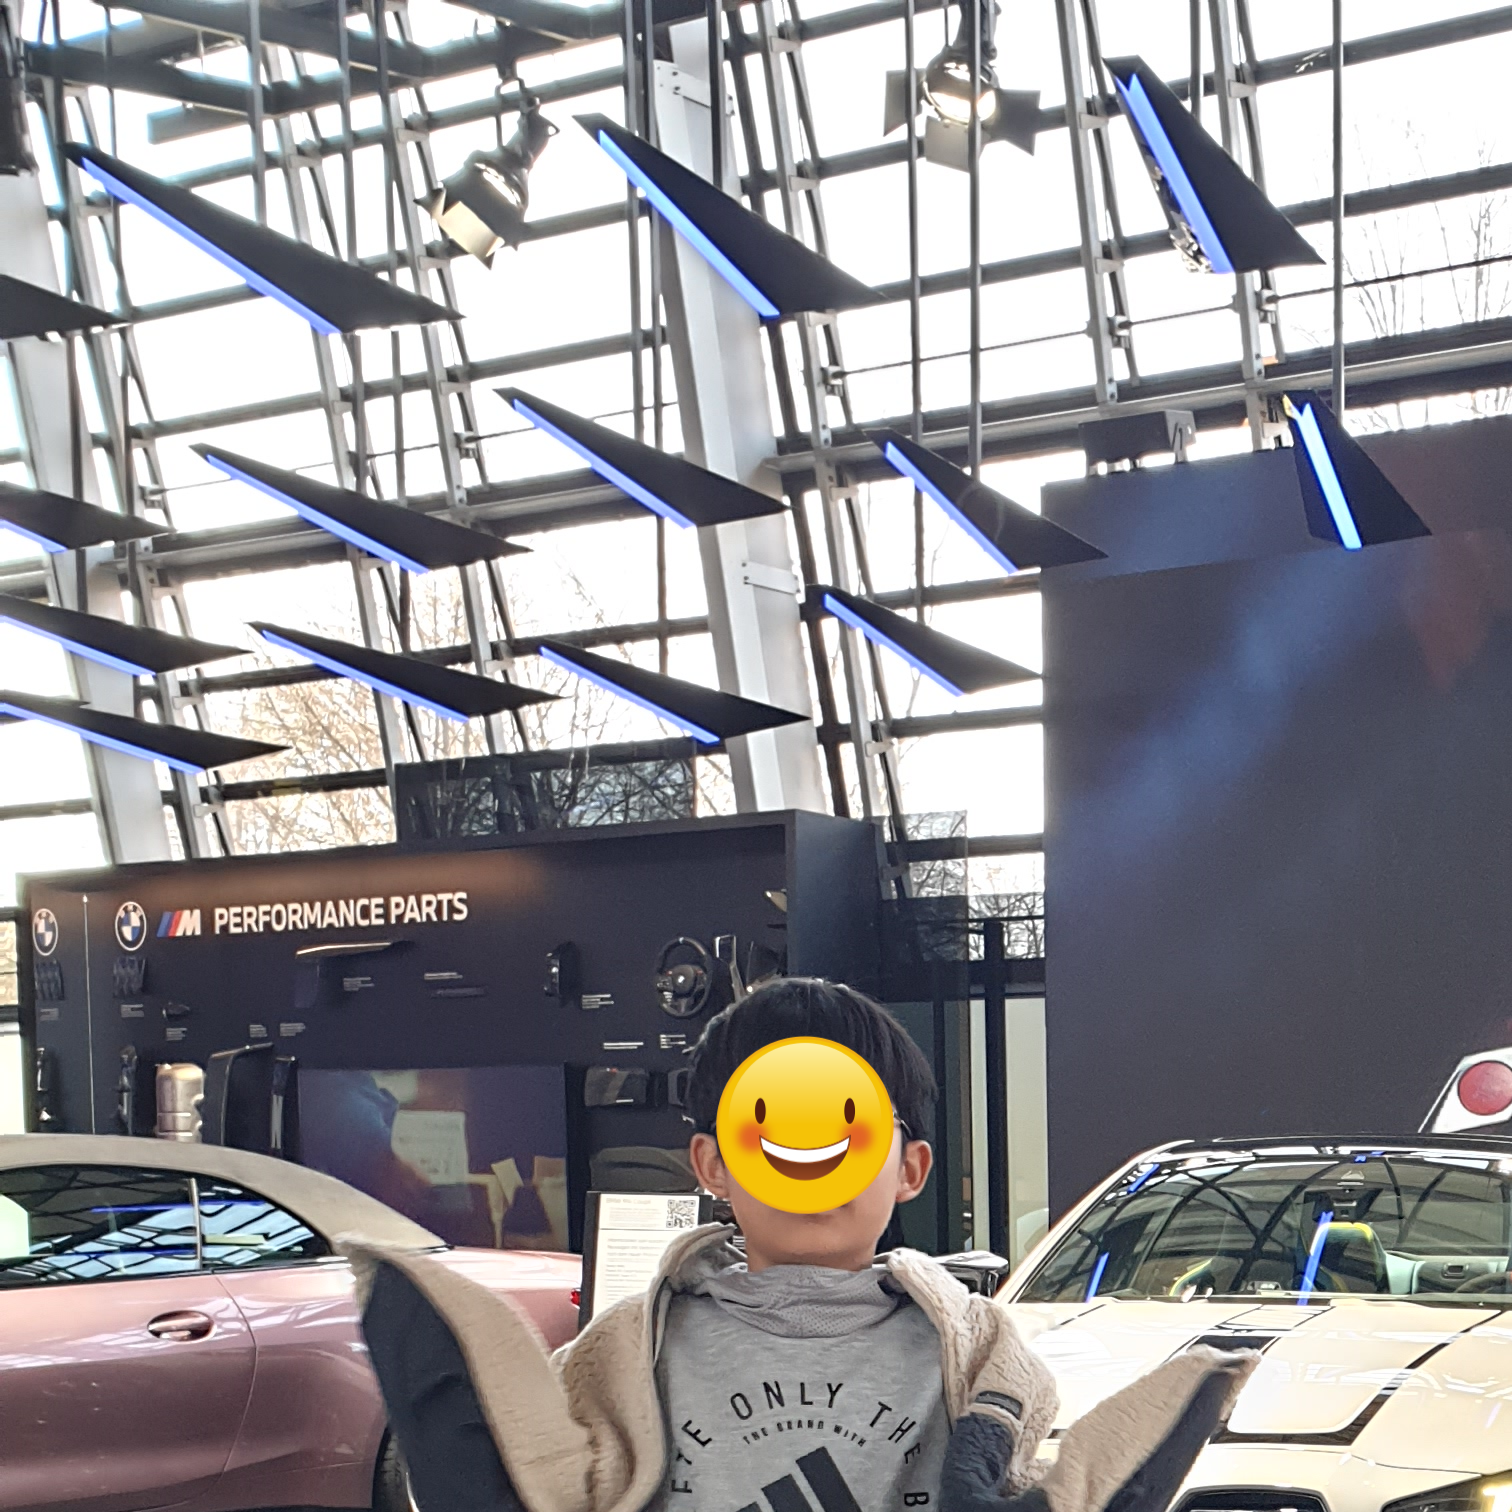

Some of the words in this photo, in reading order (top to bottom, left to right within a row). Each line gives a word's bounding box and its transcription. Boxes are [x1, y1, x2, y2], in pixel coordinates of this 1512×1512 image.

[214, 897, 385, 934] PERFORMANCE
[389, 892, 468, 924] PARTS
[730, 1380, 844, 1421] ONLY
[869, 1401, 922, 1465] THE
